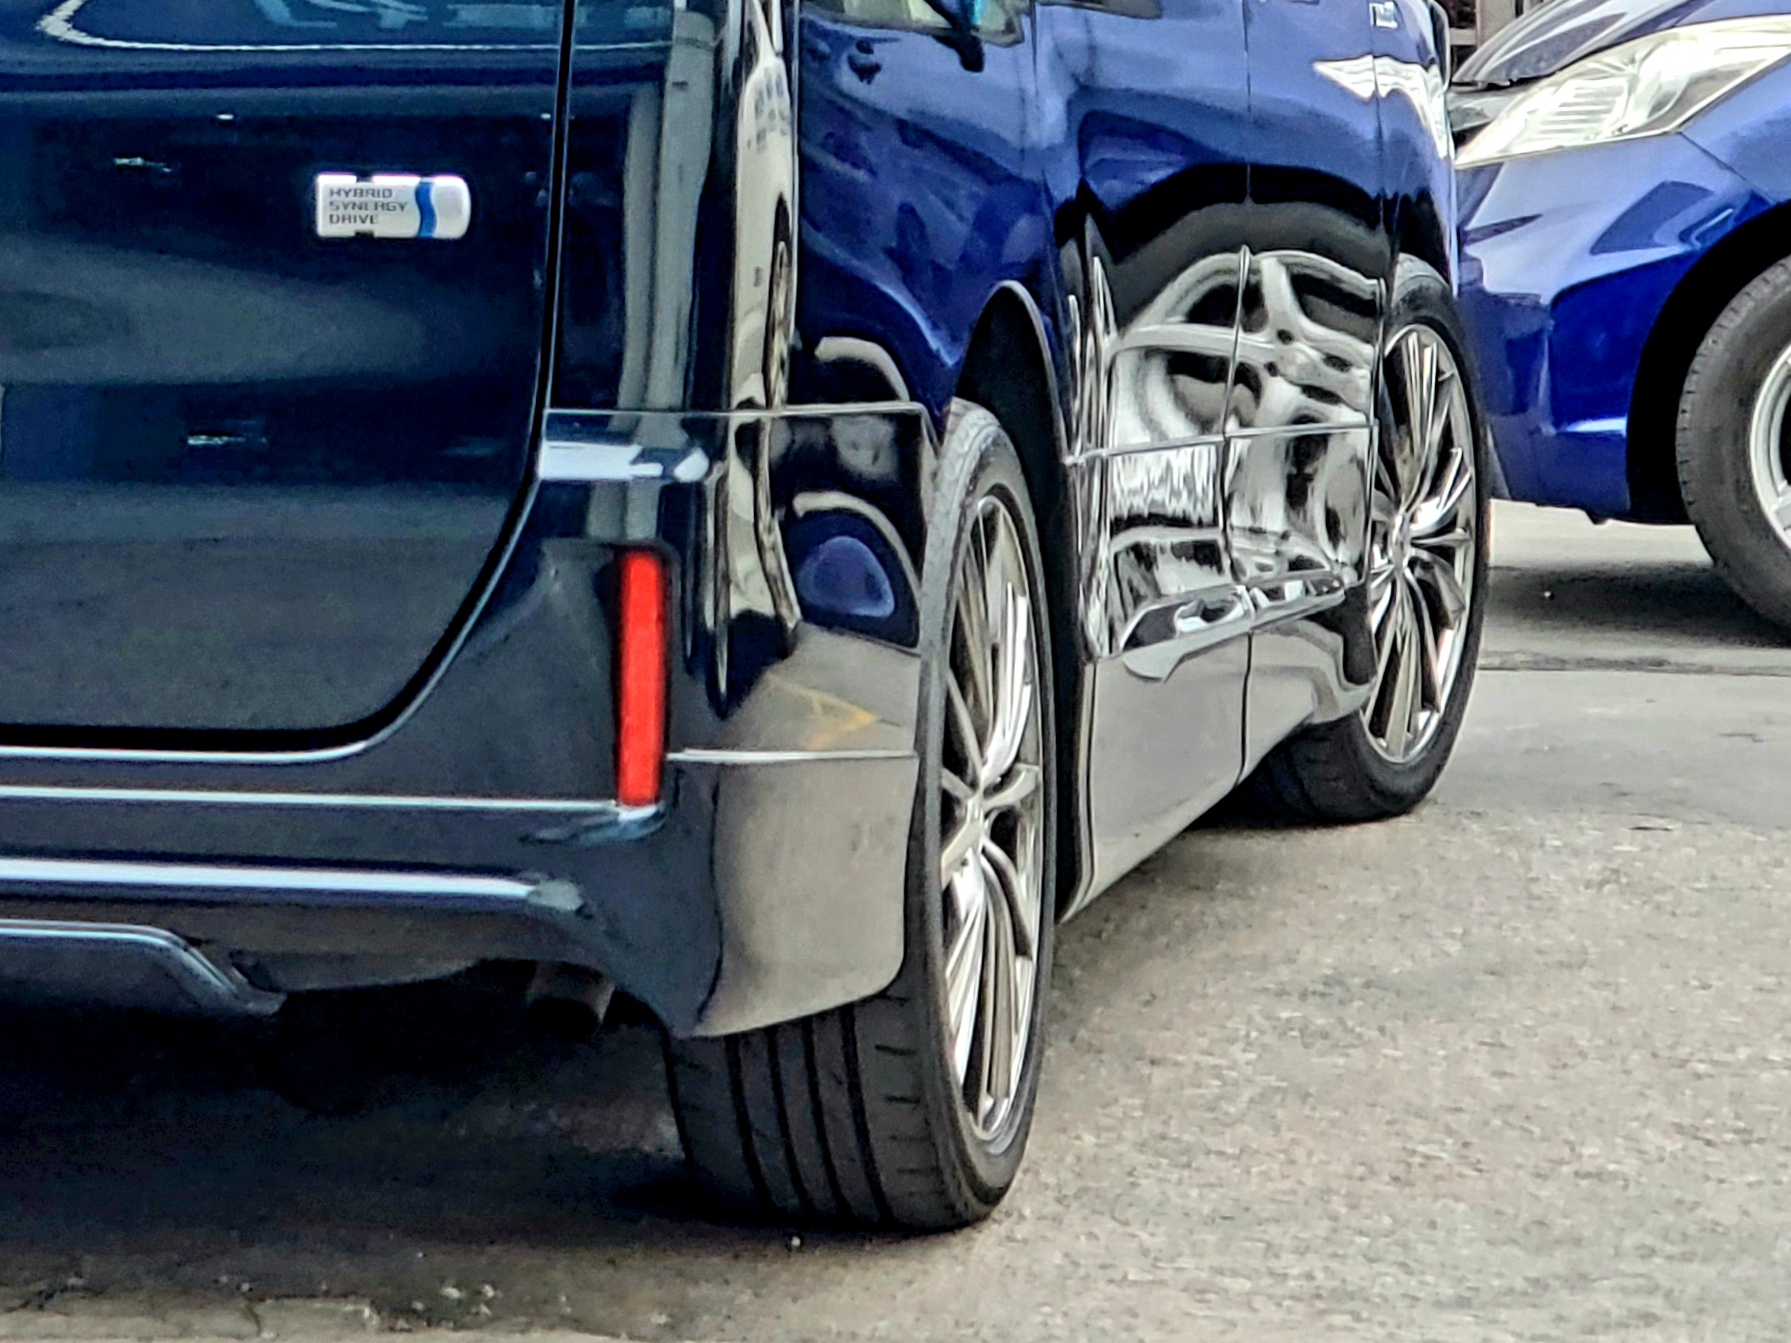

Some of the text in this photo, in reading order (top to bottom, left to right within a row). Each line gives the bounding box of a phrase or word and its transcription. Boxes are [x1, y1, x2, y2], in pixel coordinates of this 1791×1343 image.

[329, 187, 393, 199] HYBRID
[329, 200, 408, 212] SYNERGY
[329, 213, 378, 225] DRIVE
